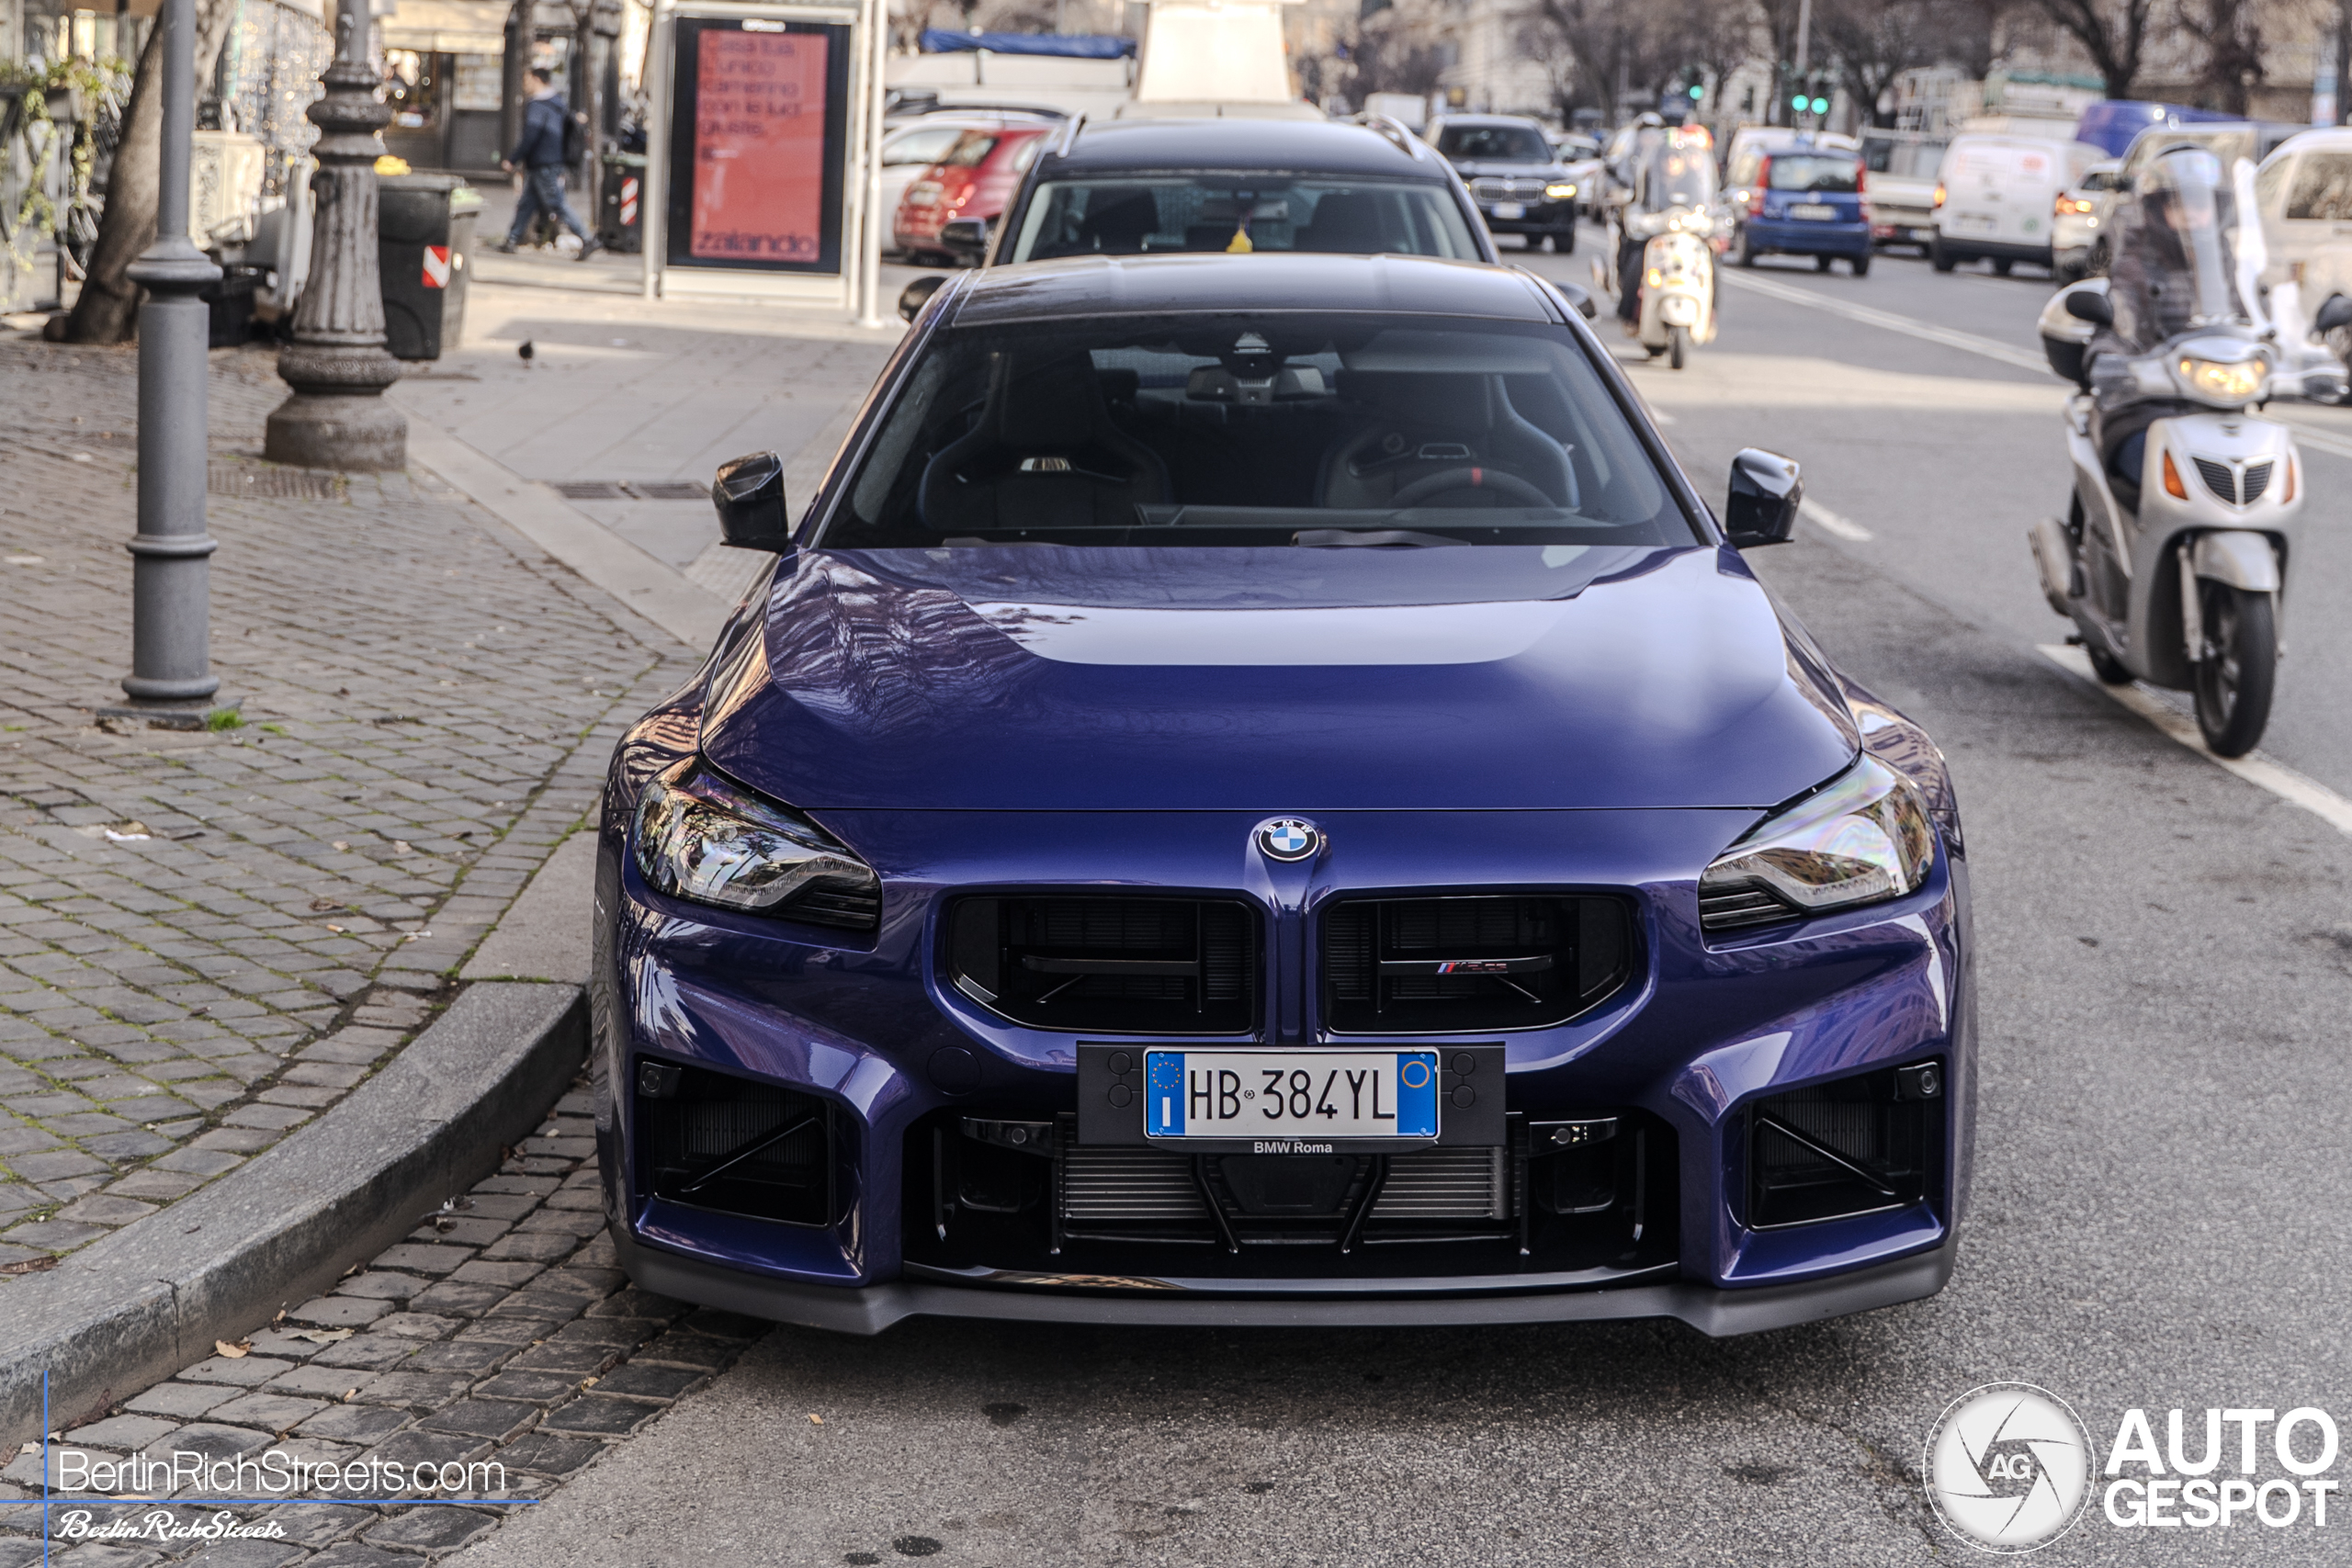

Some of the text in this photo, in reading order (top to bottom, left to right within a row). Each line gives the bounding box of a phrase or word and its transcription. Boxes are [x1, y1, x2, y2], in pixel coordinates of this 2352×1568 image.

[1265, 820, 1313, 833] BMW
[1190, 1069, 1396, 1120] HB 384YL
[1254, 1142, 1333, 1154] BMW Roma
